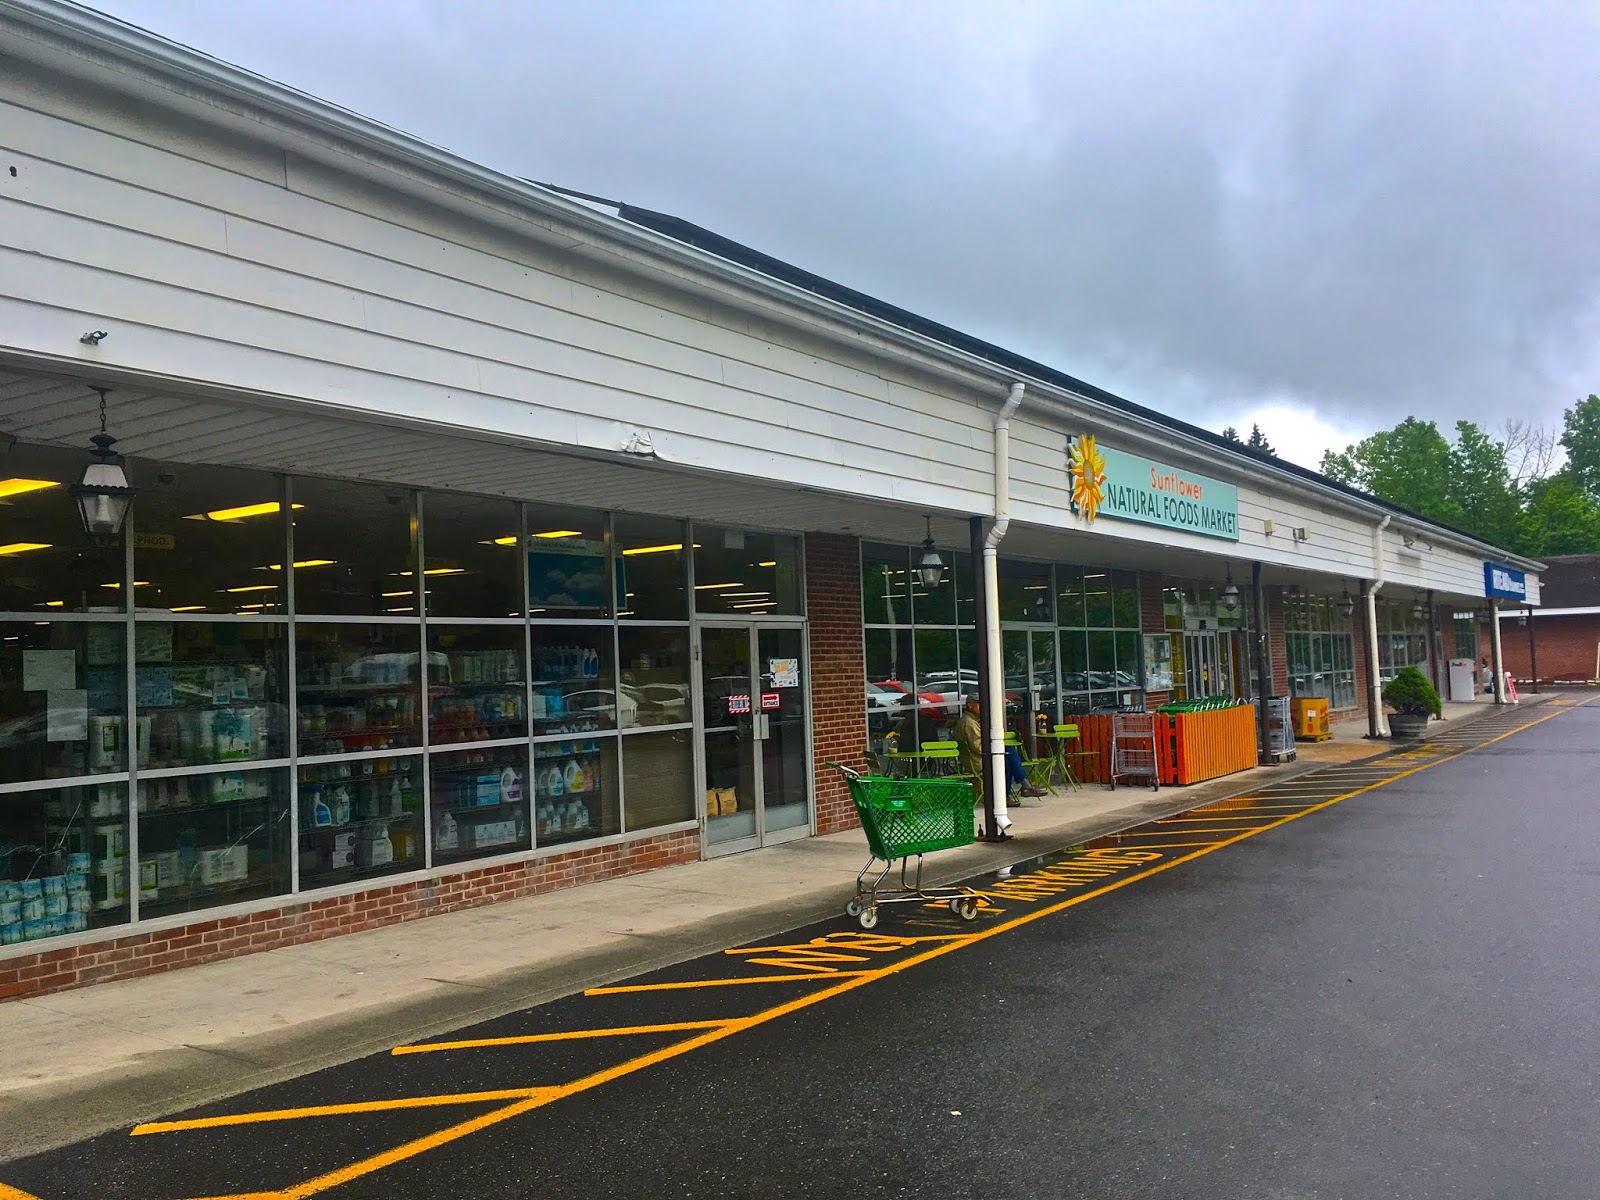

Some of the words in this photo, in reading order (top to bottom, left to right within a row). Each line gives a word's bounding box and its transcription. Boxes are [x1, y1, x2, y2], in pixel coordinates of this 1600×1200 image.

[1151, 467, 1203, 500] Sunflower
[1107, 483, 1161, 519] NATURAL
[1164, 496, 1199, 527] FOODS
[1202, 506, 1236, 534] MARKET
